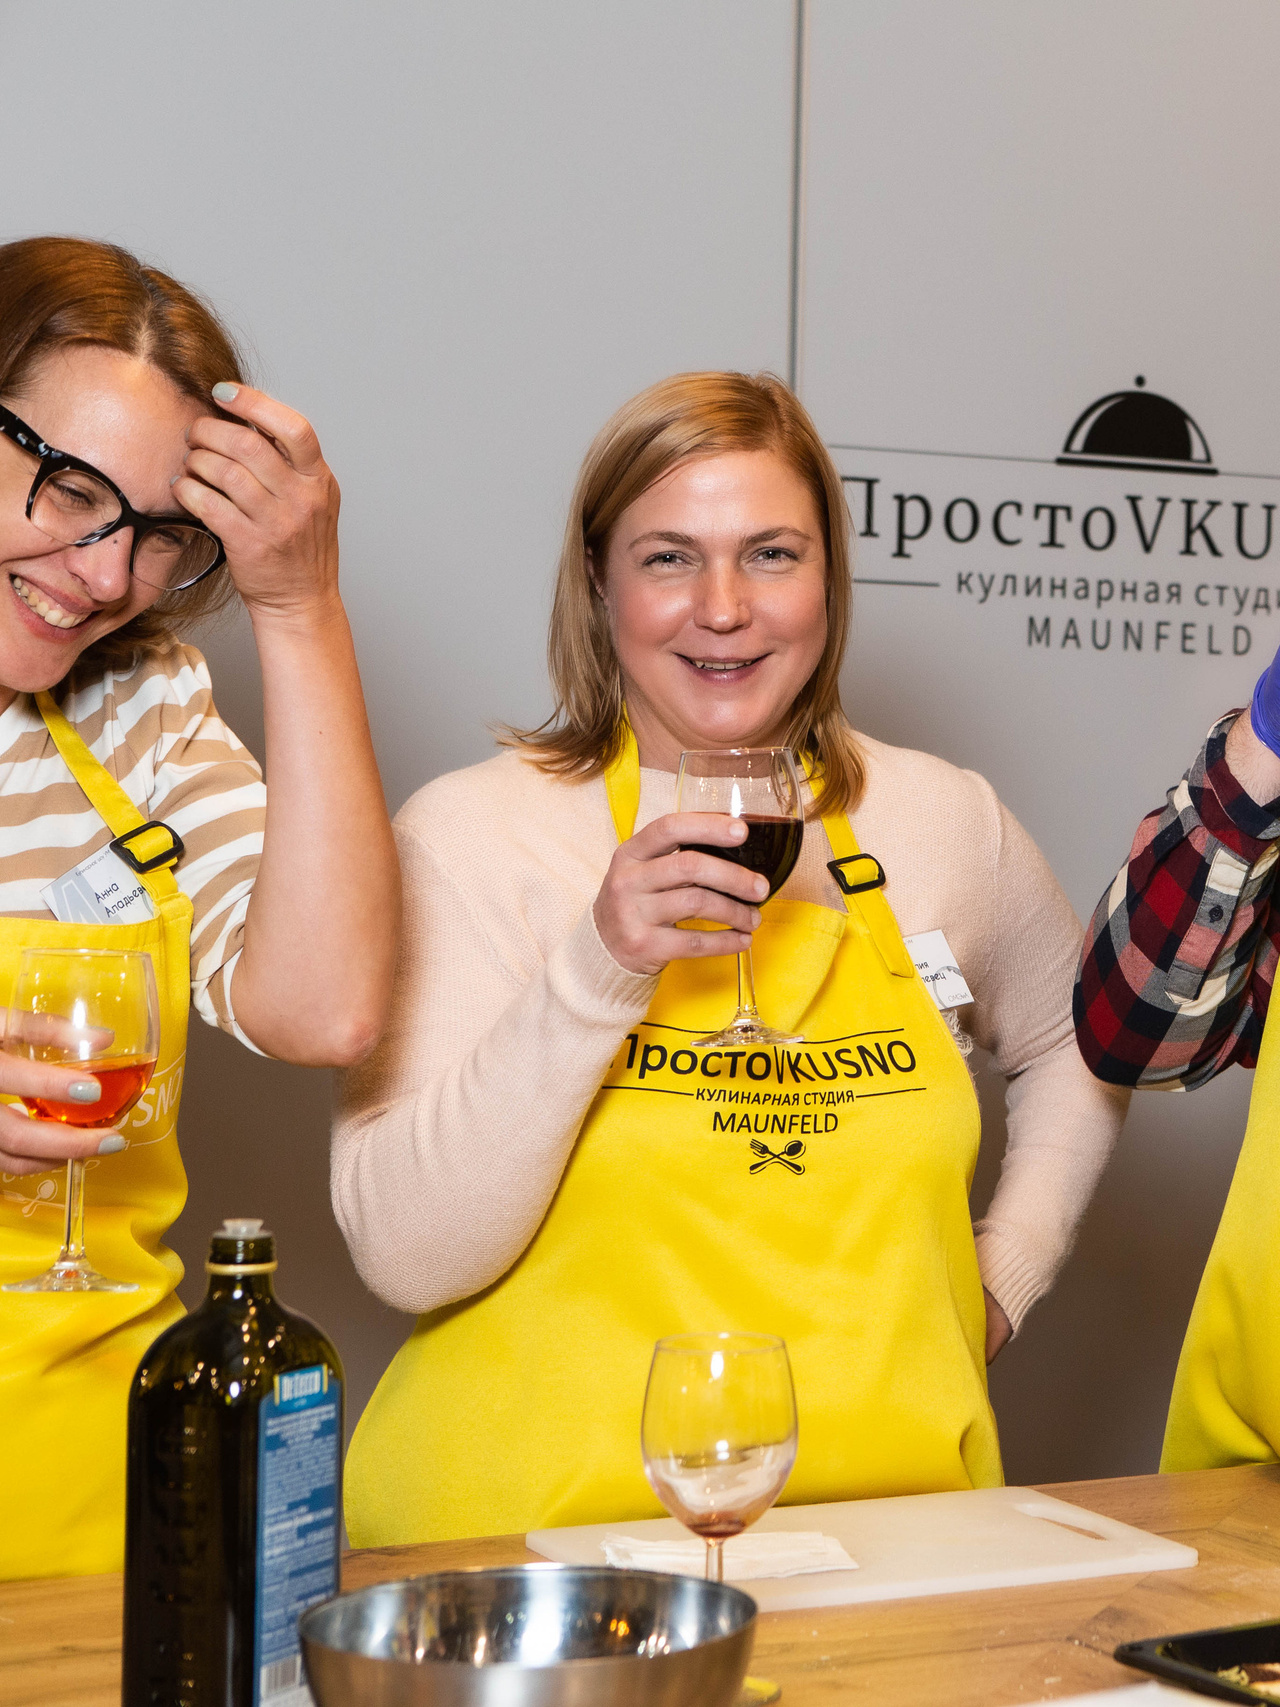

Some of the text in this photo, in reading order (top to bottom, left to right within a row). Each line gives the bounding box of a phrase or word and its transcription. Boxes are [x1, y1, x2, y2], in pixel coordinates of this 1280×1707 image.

[956, 570, 1183, 606] кулинарная
[1027, 616, 1253, 657] MAUNFELD
[94, 882, 119, 904] Анна
[696, 1088, 855, 1107] КУЛИНАРНАЯ СТУДИЯ
[712, 1111, 838, 1134] MAUNFELD
